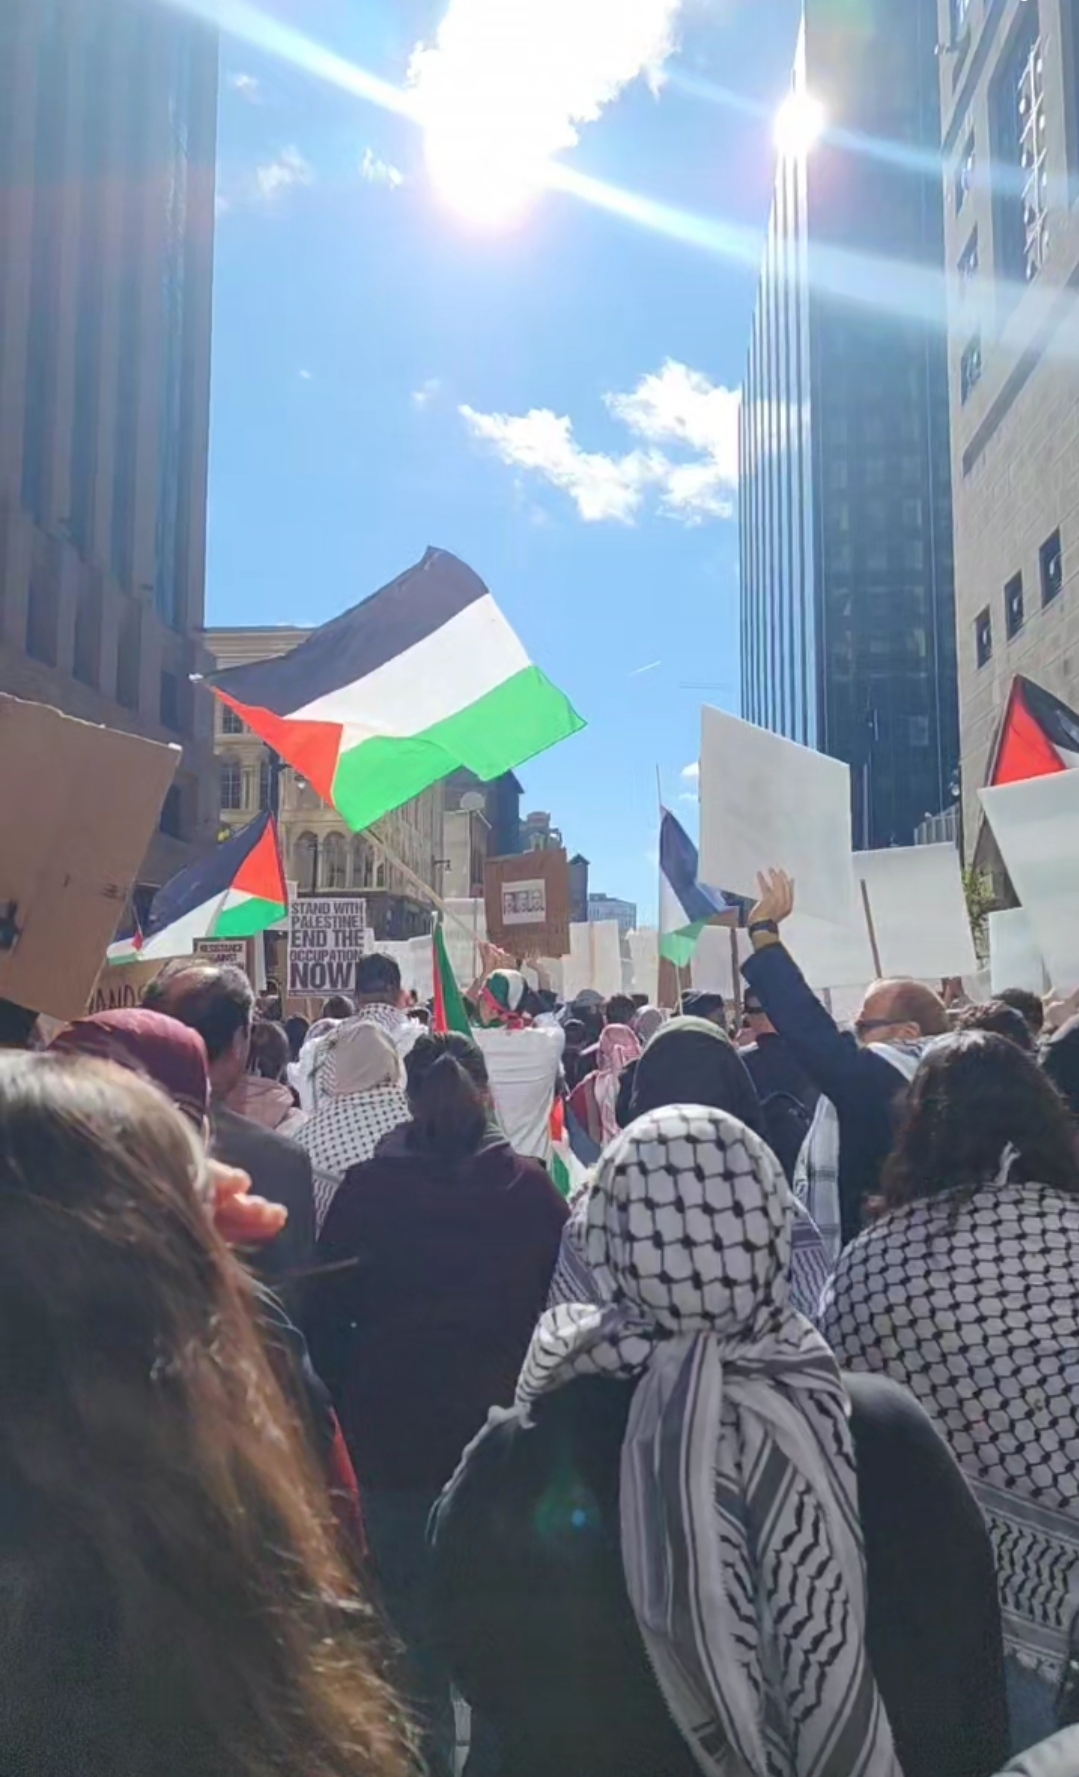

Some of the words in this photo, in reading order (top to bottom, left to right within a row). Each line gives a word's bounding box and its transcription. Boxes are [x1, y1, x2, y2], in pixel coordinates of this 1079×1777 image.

[291, 902, 330, 914] STAND
[333, 902, 362, 914] WITH
[291, 929, 327, 947] END
[332, 929, 364, 947] THE
[290, 949, 361, 961] OCCUPATION
